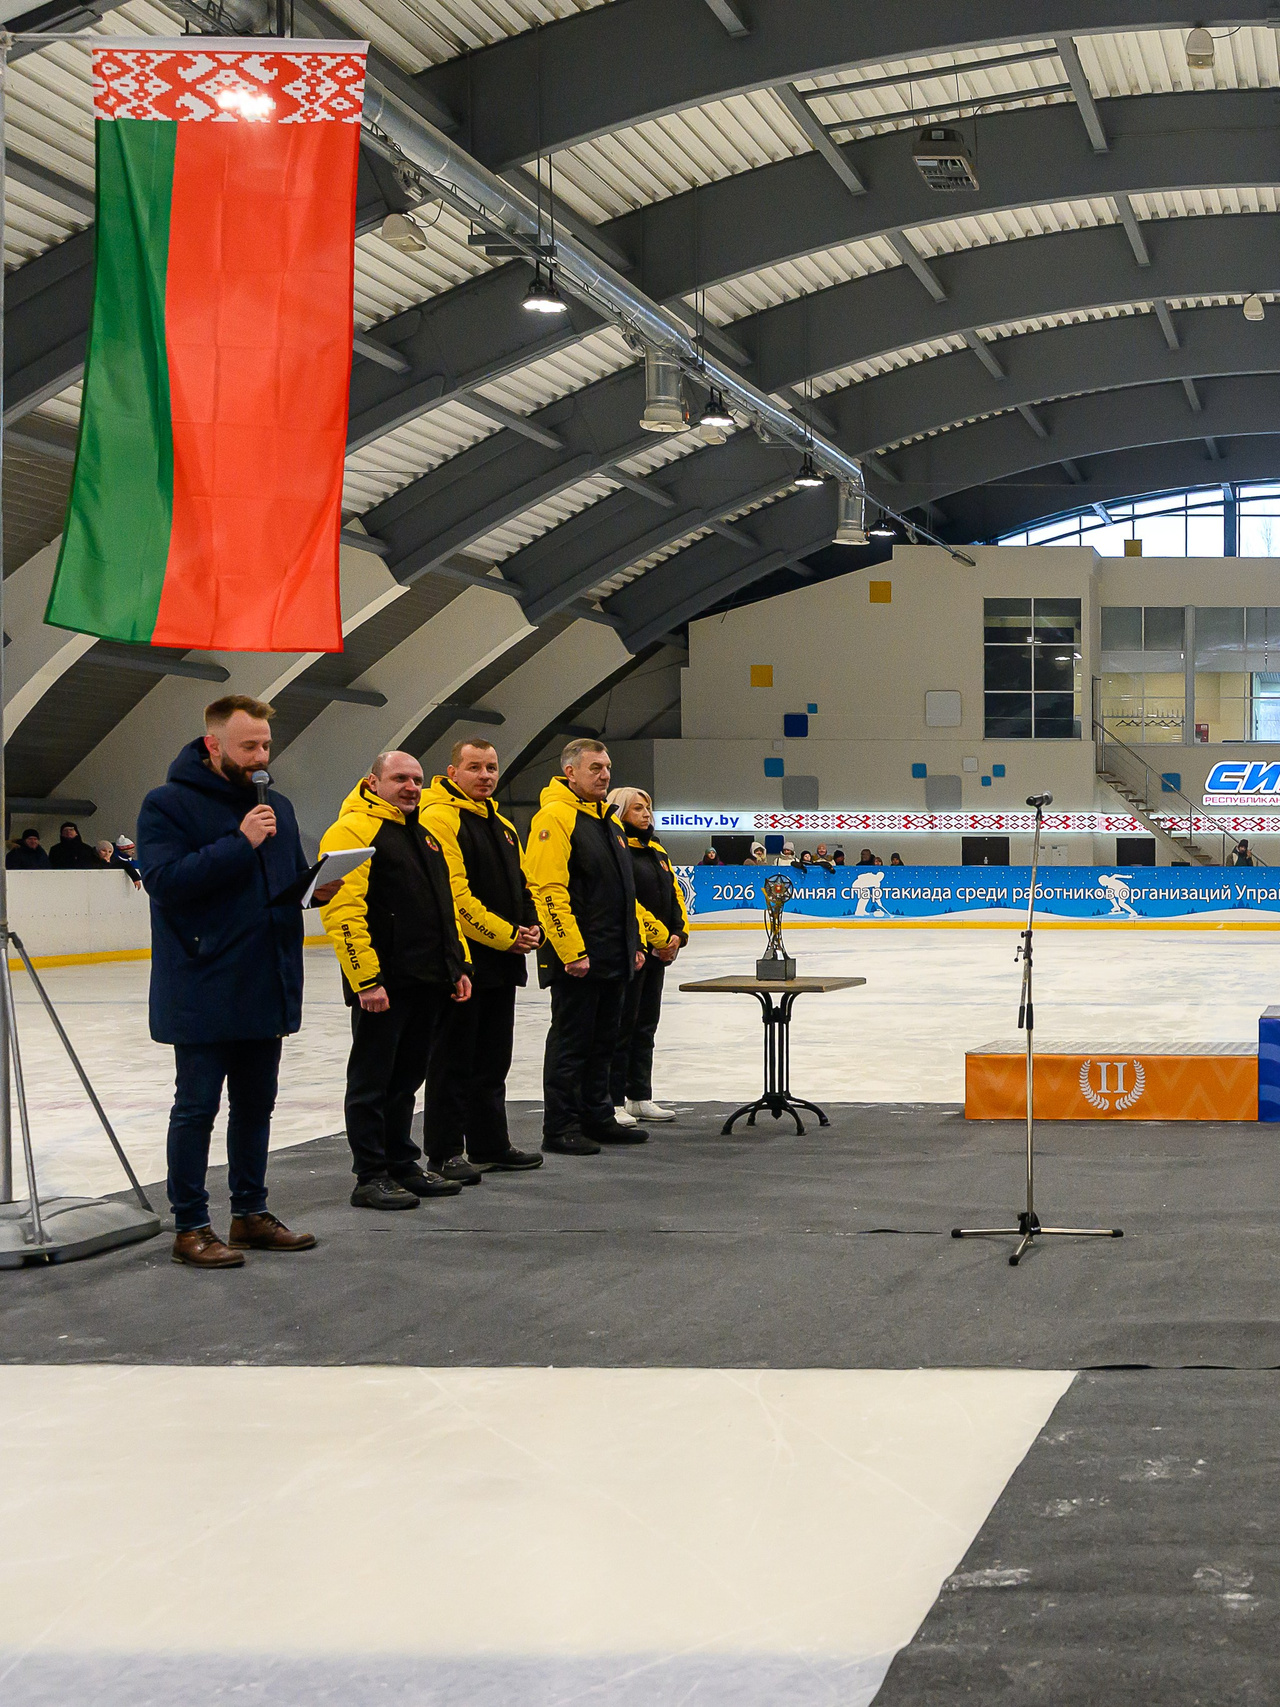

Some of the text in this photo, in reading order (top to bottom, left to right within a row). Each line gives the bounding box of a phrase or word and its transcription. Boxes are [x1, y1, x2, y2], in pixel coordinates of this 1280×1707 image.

[661, 814, 740, 828] silichy.by
[712, 884, 755, 900] 2026
[779, 887, 837, 900] мняя
[841, 887, 952, 903] спартакиада
[956, 887, 1008, 903] среди
[1012, 884, 1115, 903] работников
[1119, 884, 1231, 904] организаций
[459, 907, 497, 940] BELARUS
[545, 895, 566, 938] BELARUS
[341, 924, 361, 970] BELARUS
[1096, 1062, 1128, 1093] II
